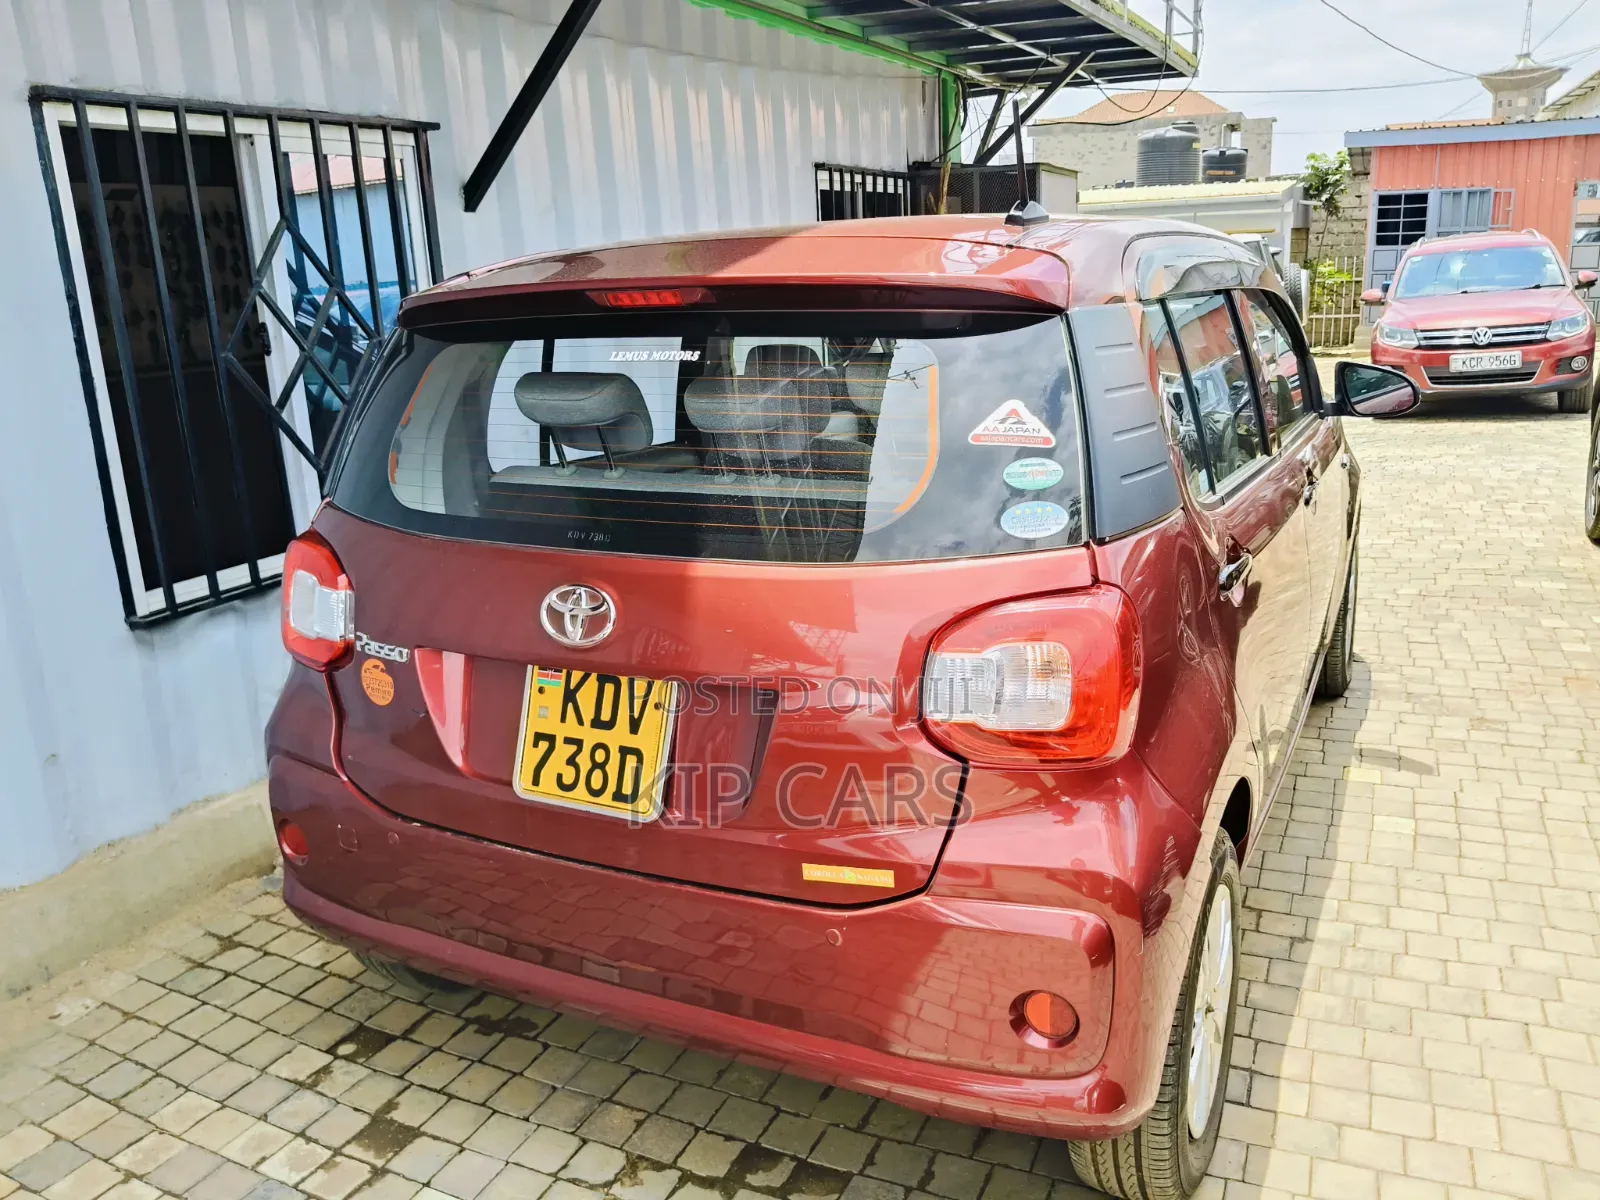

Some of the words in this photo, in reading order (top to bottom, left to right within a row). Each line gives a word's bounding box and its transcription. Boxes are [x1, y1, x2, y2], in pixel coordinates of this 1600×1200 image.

[609, 351, 649, 361] LEMUS
[650, 351, 701, 361] MOTORS
[1461, 357, 1483, 369] KCR
[1488, 354, 1517, 369] 956G
[567, 530, 586, 539] KDV
[560, 669, 655, 735] KDV
[532, 731, 644, 804] 738D
